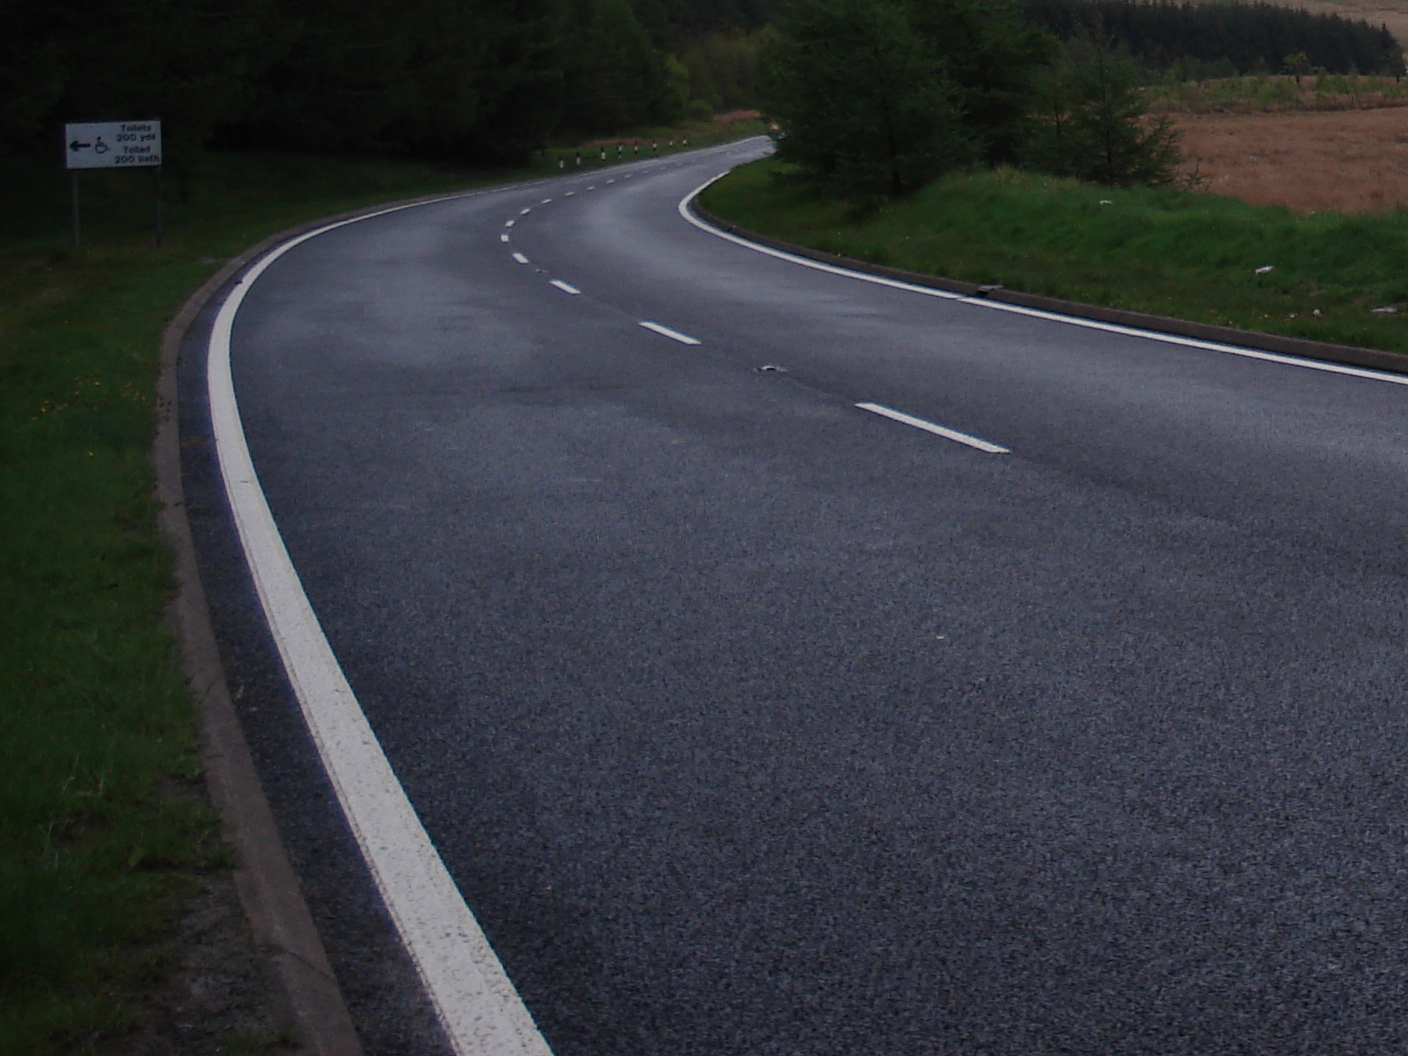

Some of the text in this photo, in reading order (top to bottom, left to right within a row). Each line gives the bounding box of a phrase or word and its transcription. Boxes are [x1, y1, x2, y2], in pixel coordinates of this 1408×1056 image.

[121, 124, 152, 132] Toilets
[116, 133, 156, 142] 200 yds
[114, 155, 136, 164] 200
